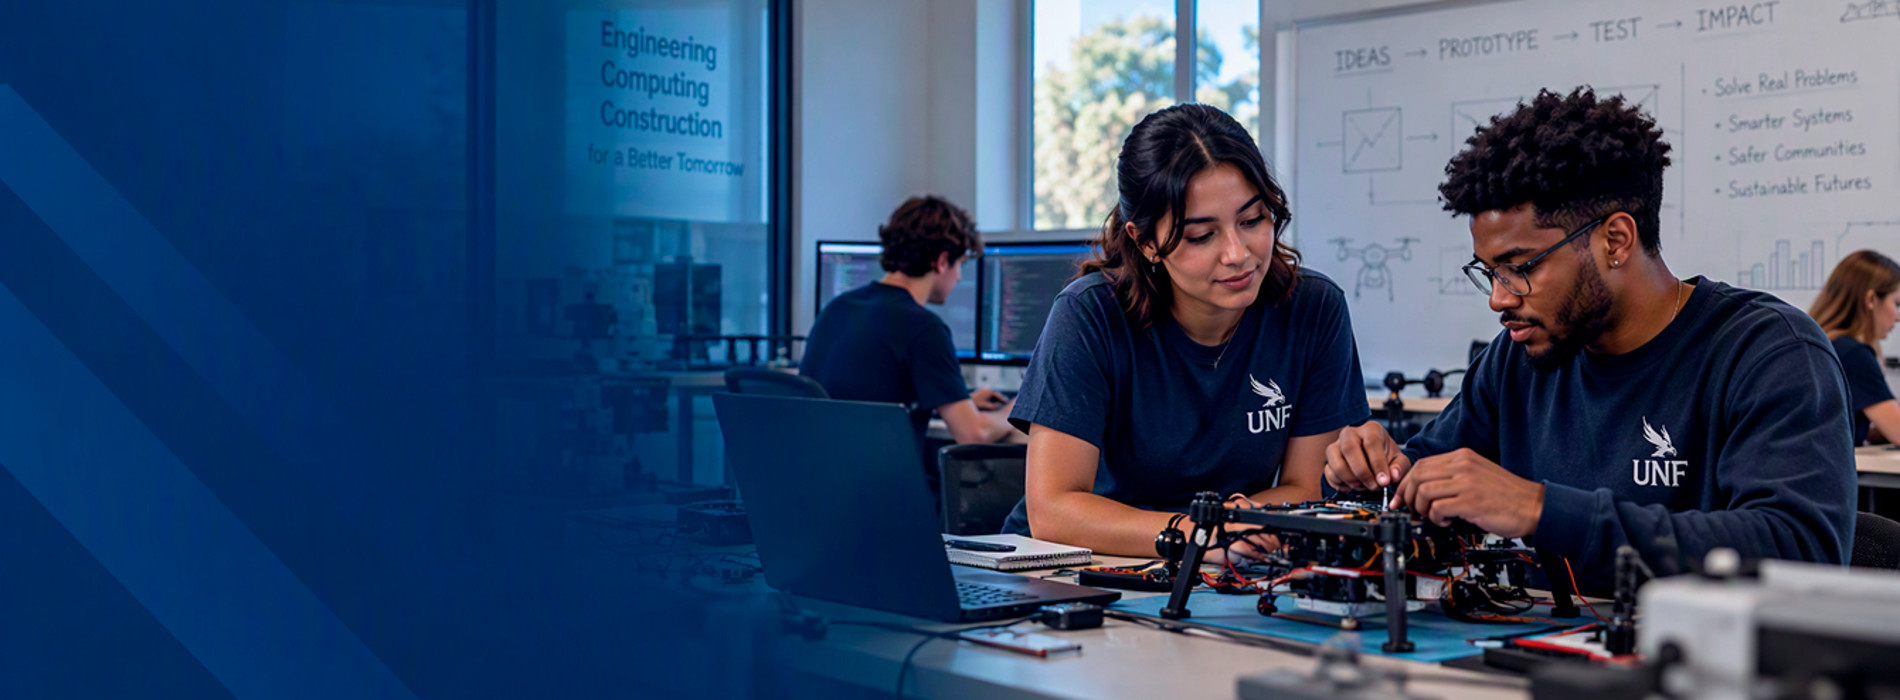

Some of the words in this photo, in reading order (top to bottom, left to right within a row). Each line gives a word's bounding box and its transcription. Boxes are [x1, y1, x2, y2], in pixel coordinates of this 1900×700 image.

[601, 20, 717, 71] Engineering
[1335, 46, 1391, 72] IDEAS
[1439, 29, 1539, 61] PROTOTYPE
[1590, 17, 1642, 43] TEST
[1695, 1, 1780, 32] IMPACT
[601, 60, 710, 107] Computing
[1714, 76, 1751, 97] Solve
[1758, 71, 1788, 92] Real
[1795, 68, 1858, 88] Problems
[601, 100, 722, 139] Construction
[1728, 114, 1786, 133] Smarter
[1792, 106, 1853, 132] Systems
[588, 142, 609, 165] for
[613, 151, 623, 167] a
[627, 147, 674, 172] Better
[676, 152, 745, 177] Tomorrow
[1728, 145, 1767, 166] Safer
[1774, 140, 1866, 162] Communities
[1728, 177, 1807, 199] Sustainable
[1814, 173, 1872, 193] Futures
[1247, 404, 1292, 434] UNF
[1632, 459, 1688, 487] UNF
